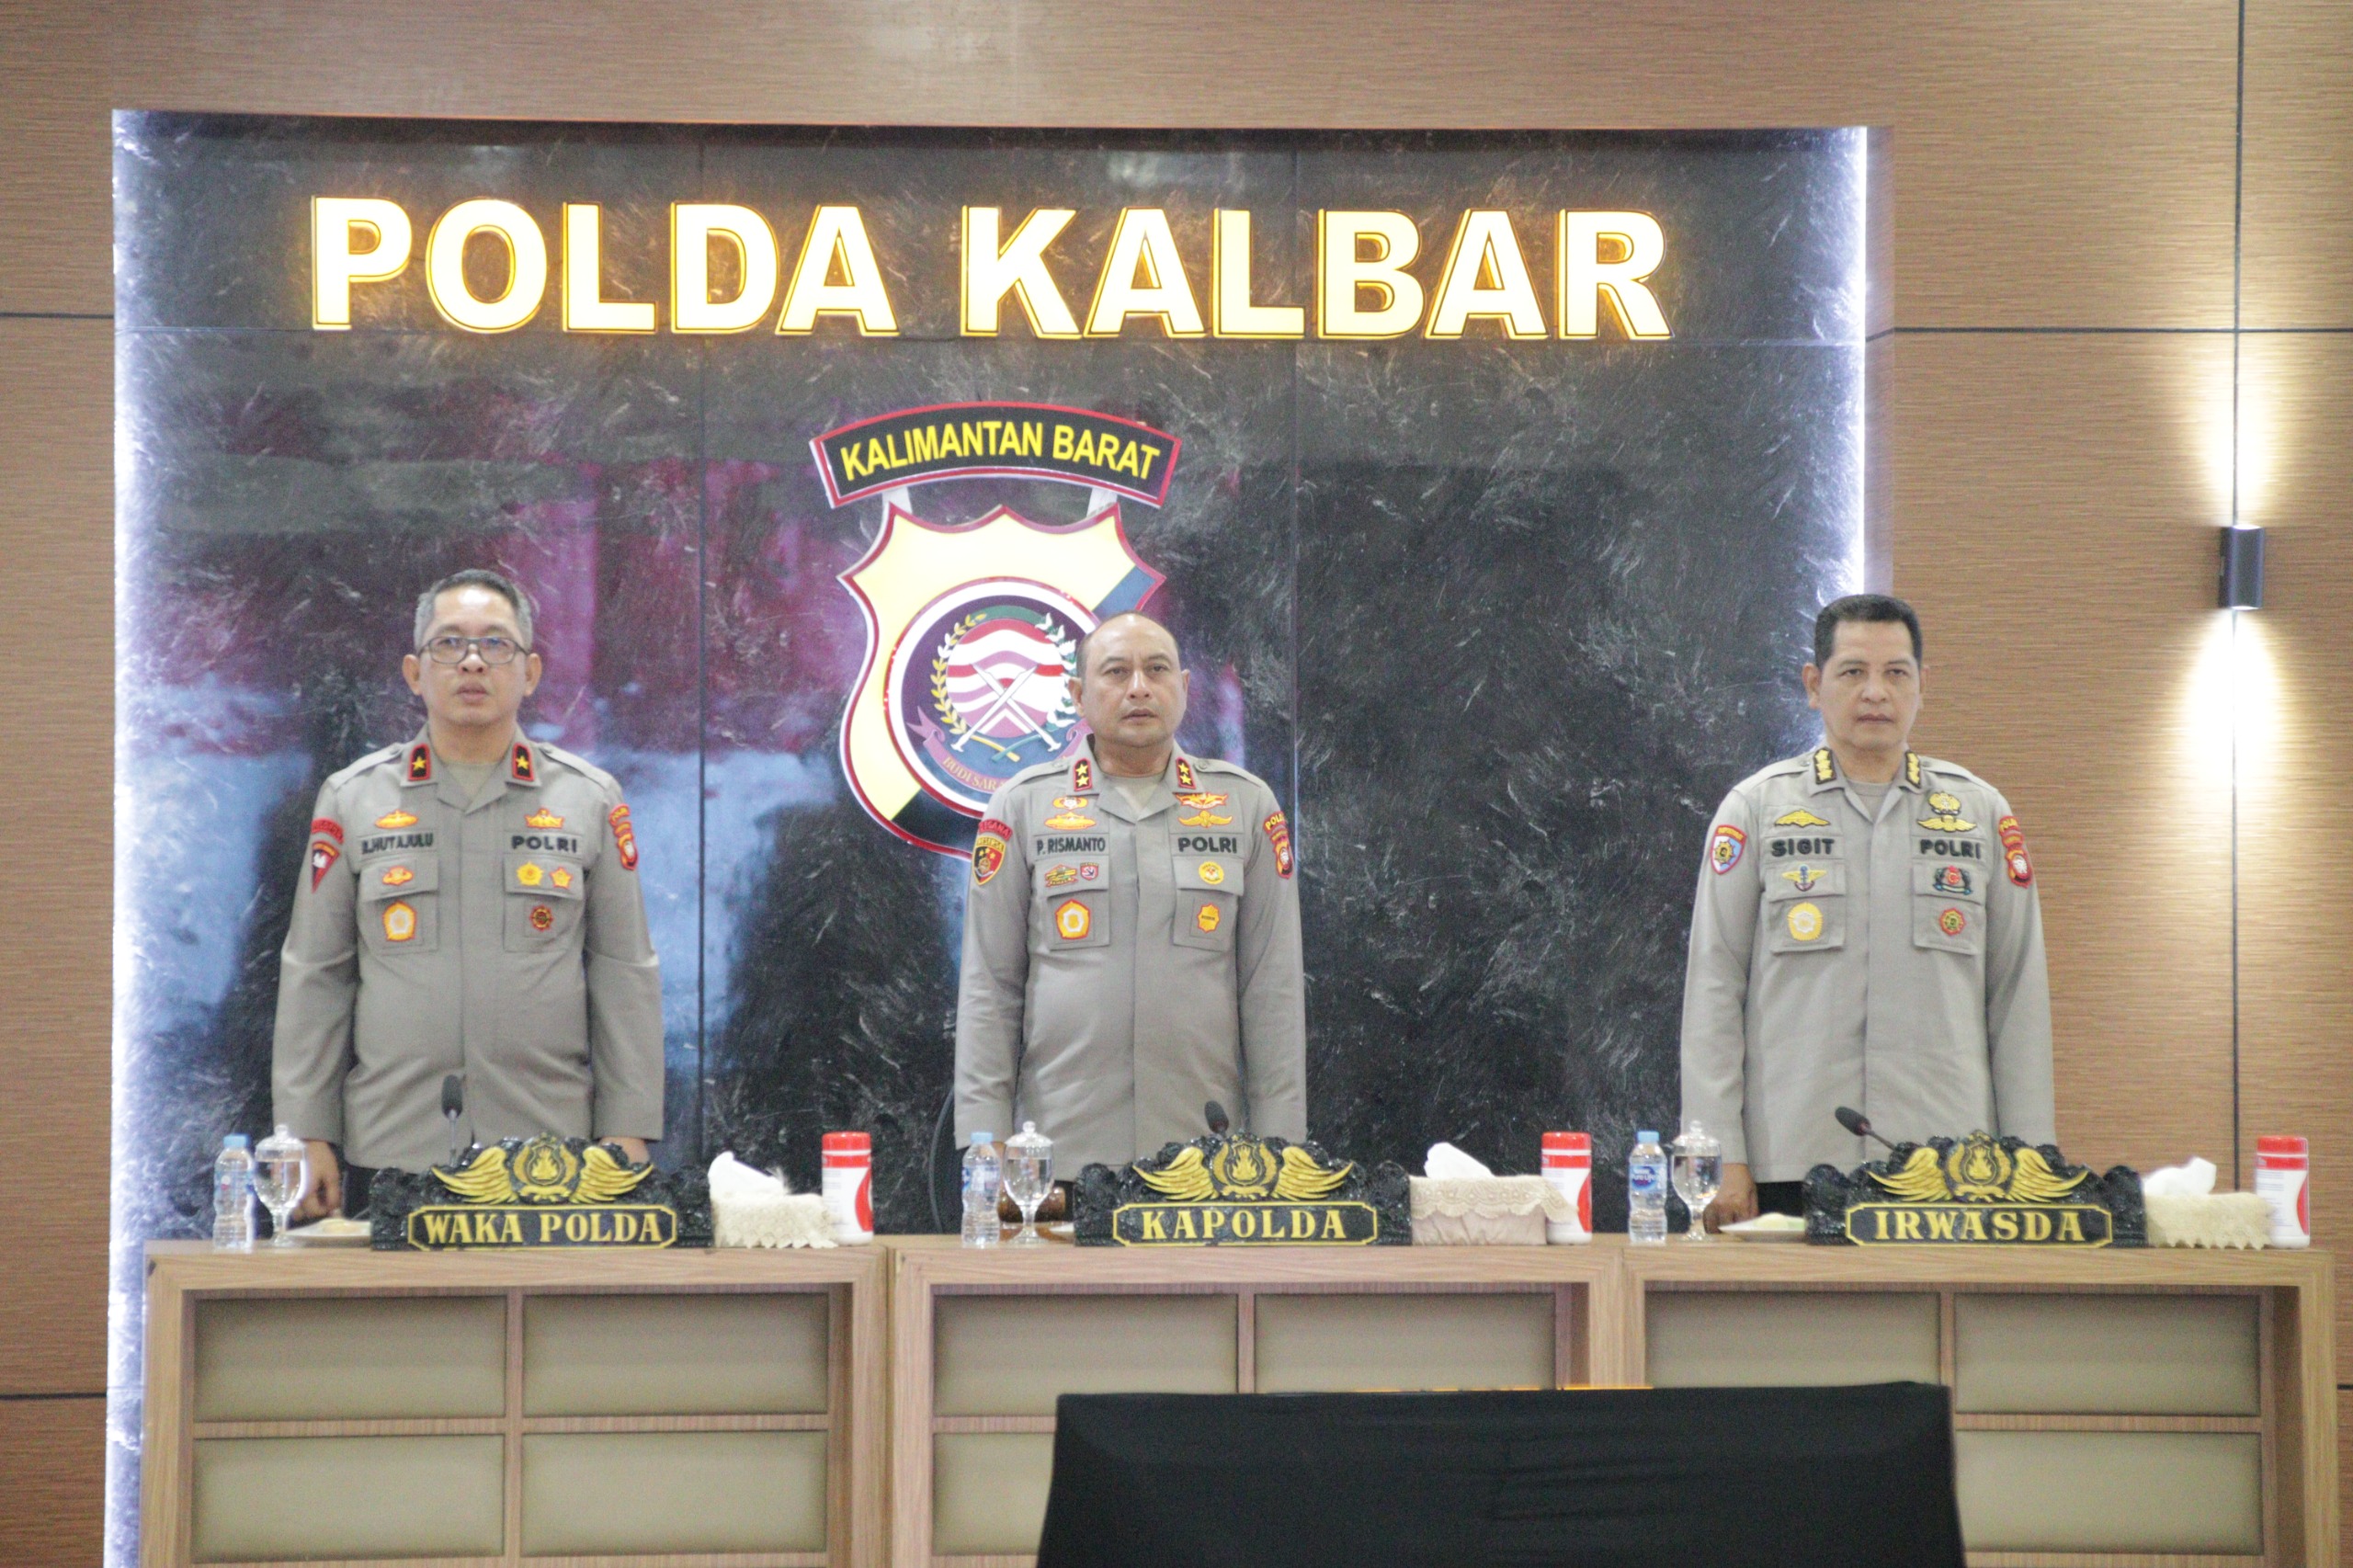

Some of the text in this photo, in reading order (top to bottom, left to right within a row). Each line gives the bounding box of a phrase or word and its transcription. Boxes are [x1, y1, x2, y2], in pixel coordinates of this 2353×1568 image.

[312, 195, 1673, 341] POLDA KALBAR
[840, 420, 1161, 482] KALIMANTAN BARAT
[943, 756, 1006, 790] BUDI SAR
[511, 834, 578, 853] POLRI
[1047, 836, 1107, 854] RISMANTO
[1177, 836, 1237, 854] POLRI
[1770, 837, 1835, 858] SIGIT
[1919, 838, 1982, 859] POLRI
[423, 1212, 664, 1244] WAKA POLDA
[1141, 1209, 1348, 1241] KAPOLDA
[1874, 1210, 2086, 1243] IRWASDA
